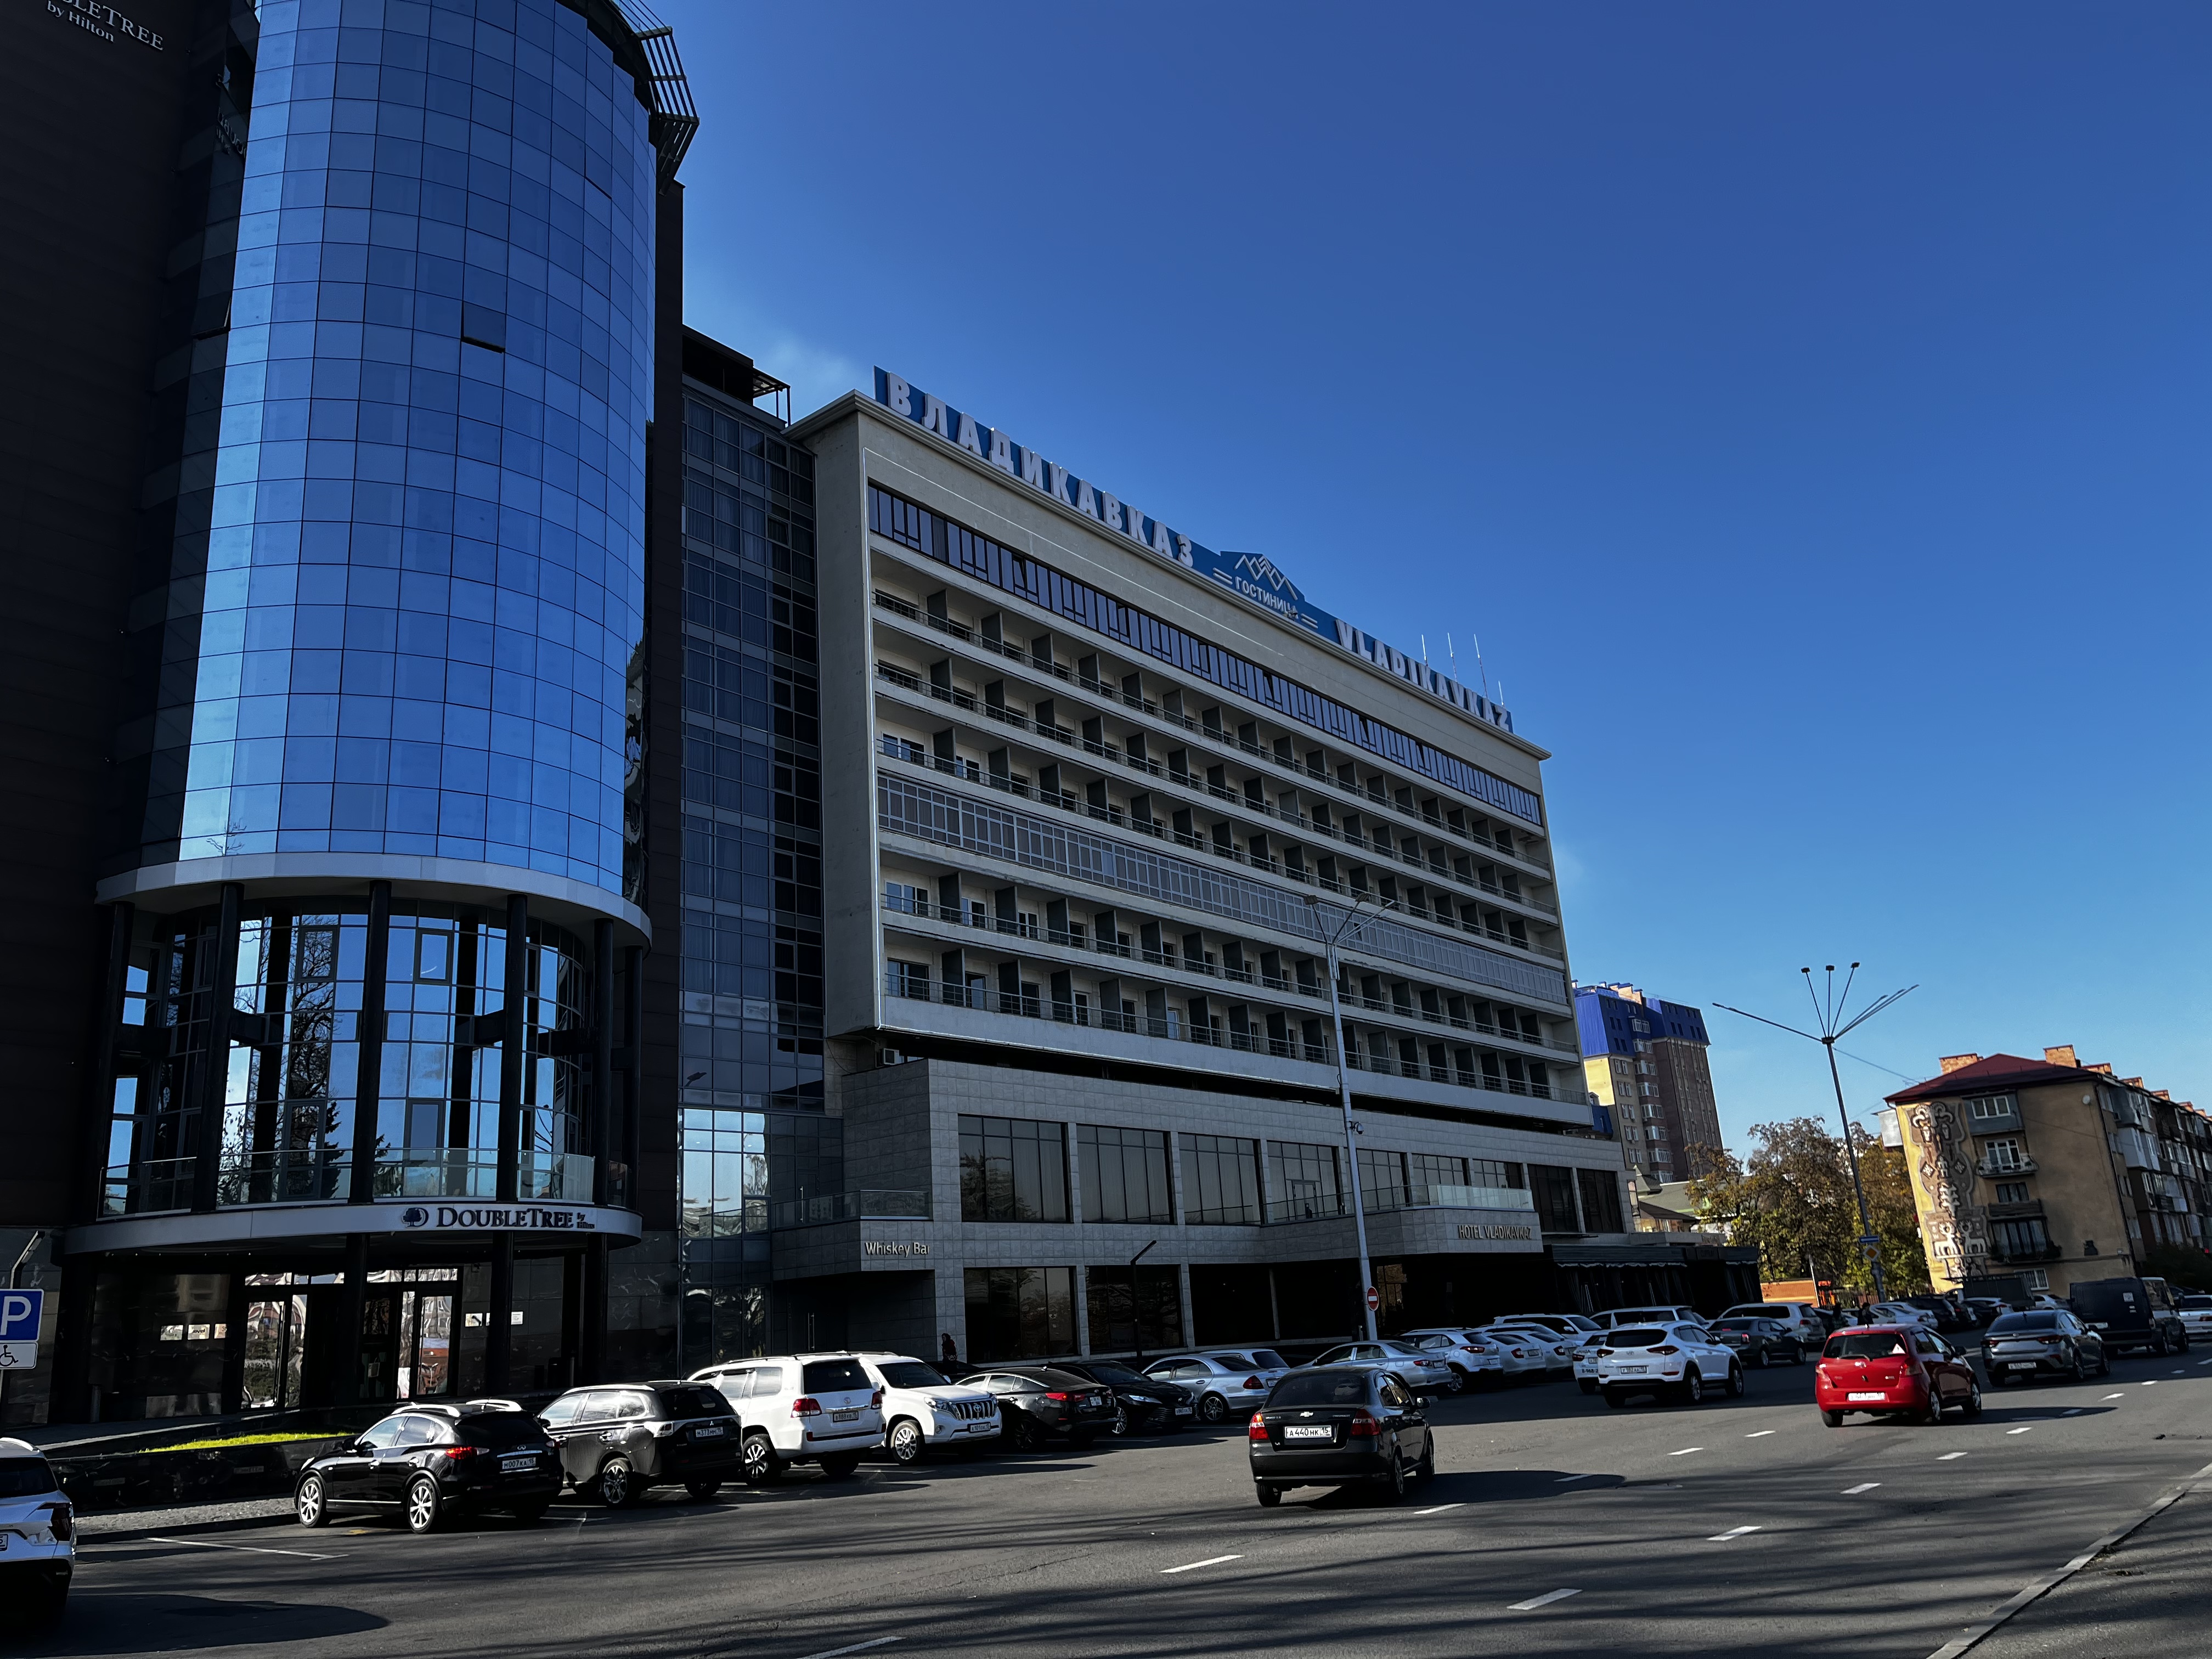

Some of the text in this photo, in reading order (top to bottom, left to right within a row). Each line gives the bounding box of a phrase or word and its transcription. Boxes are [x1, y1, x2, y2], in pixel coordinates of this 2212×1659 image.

[47, 1, 114, 42] by Hilton
[62, 0, 164, 51] LETREE
[887, 371, 1193, 568] ВЛАДИКАВКАЗ
[1335, 619, 1510, 730] VLADIKAVKAZ
[865, 1242, 911, 1257] Whiskey
[1458, 1224, 1532, 1240] HOTEL VLADIKAVKAZ
[1, 1296, 32, 1336] P
